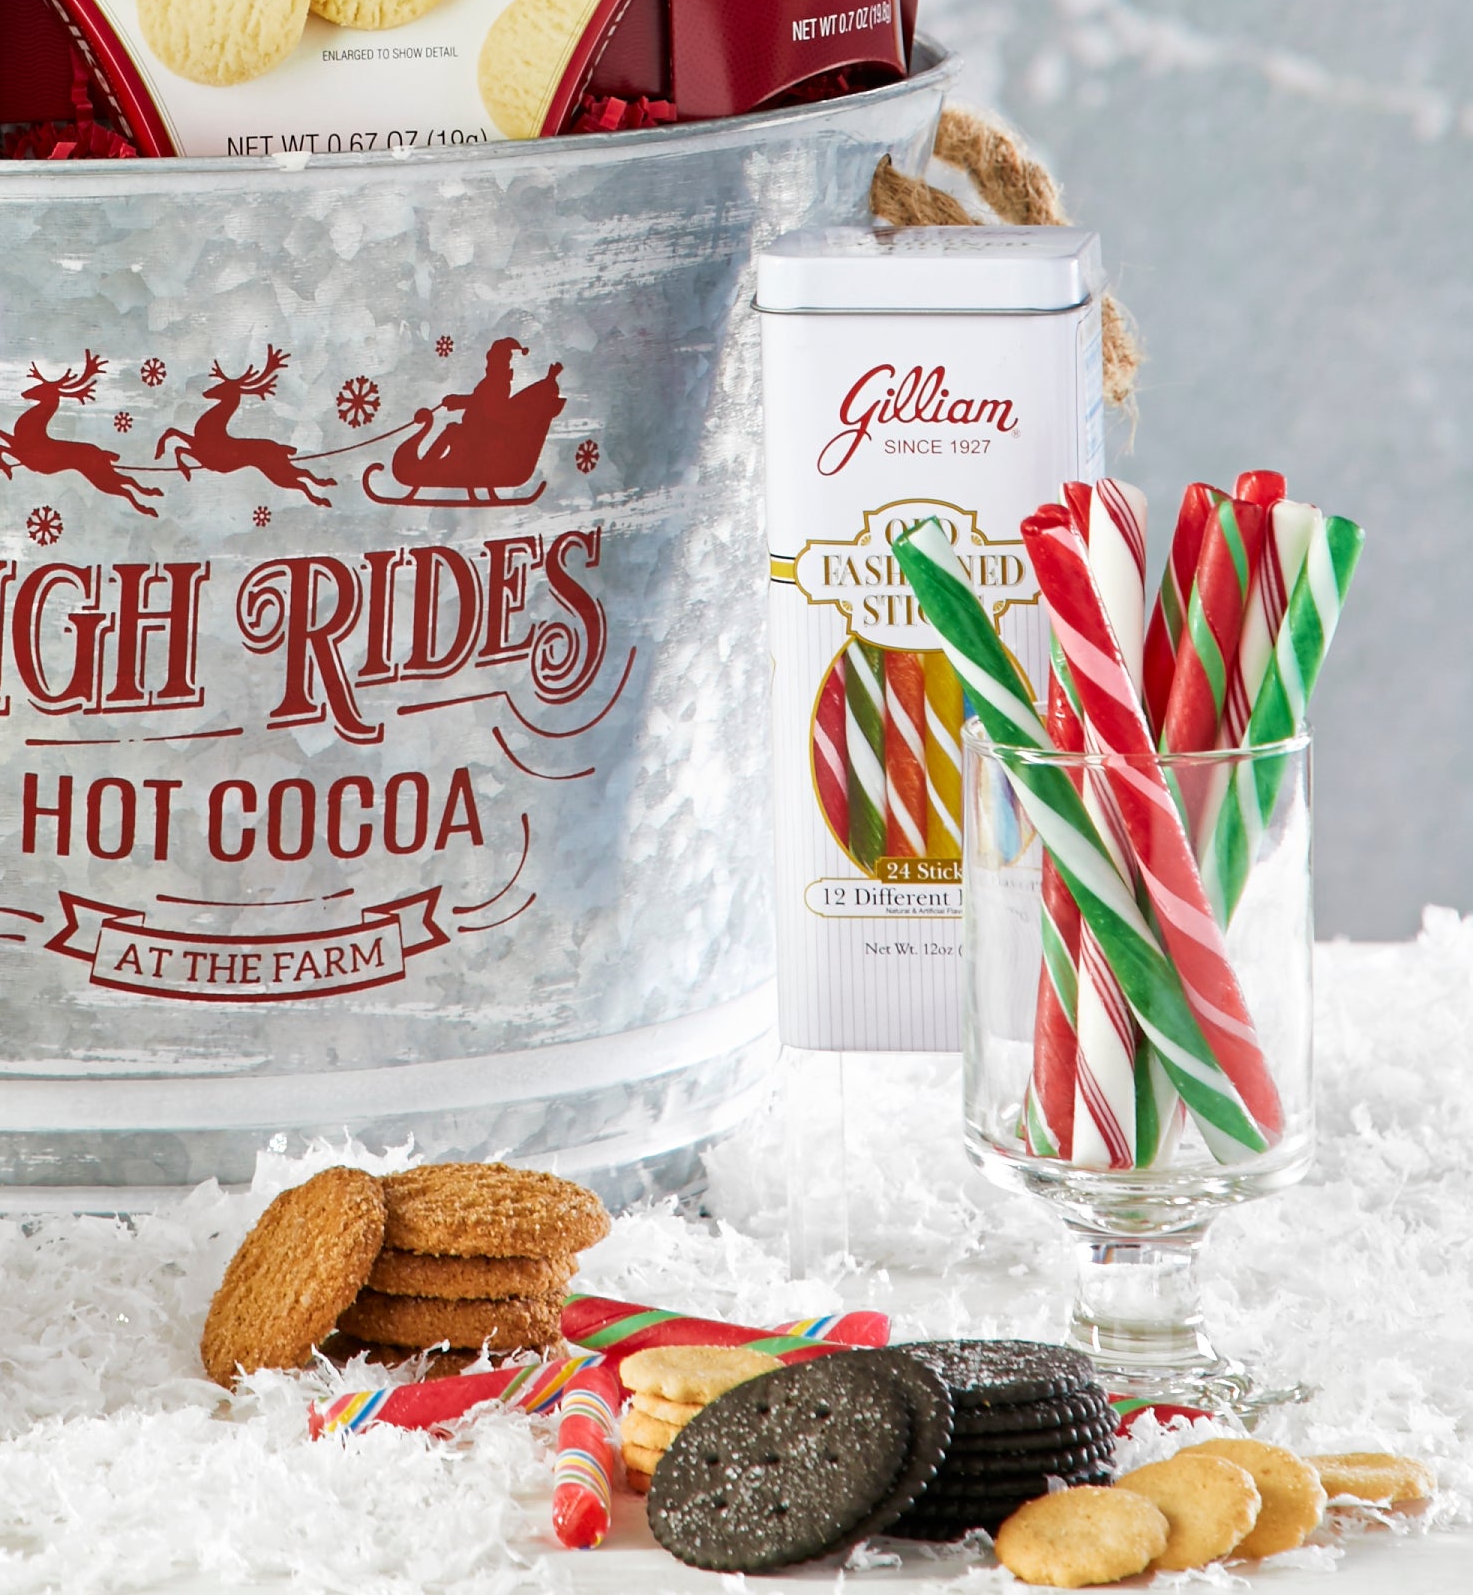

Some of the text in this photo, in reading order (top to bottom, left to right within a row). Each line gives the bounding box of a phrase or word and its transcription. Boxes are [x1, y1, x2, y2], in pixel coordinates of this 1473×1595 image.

[792, 18, 817, 41] NET
[819, 14, 838, 37] WT
[839, 11, 855, 34] 0.7
[856, 7, 869, 30] OZ
[322, 46, 459, 62] ENLARGED TO SHOW DETAIL
[817, 364, 1019, 476] Gilliam
[884, 439, 991, 454] SINCE 1927
[822, 554, 1027, 588] FASHNED
[236, 525, 612, 744] RIDES
[22, 772, 184, 862] HOT
[208, 767, 484, 862] COCOA
[887, 861, 963, 880] 24 Stick
[824, 888, 846, 905] 12
[855, 887, 950, 905] Different
[113, 937, 385, 984] AT THE FARM
[865, 943, 891, 955] Net
[894, 942, 918, 955] Wt.
[924, 942, 953, 955] 12oz
